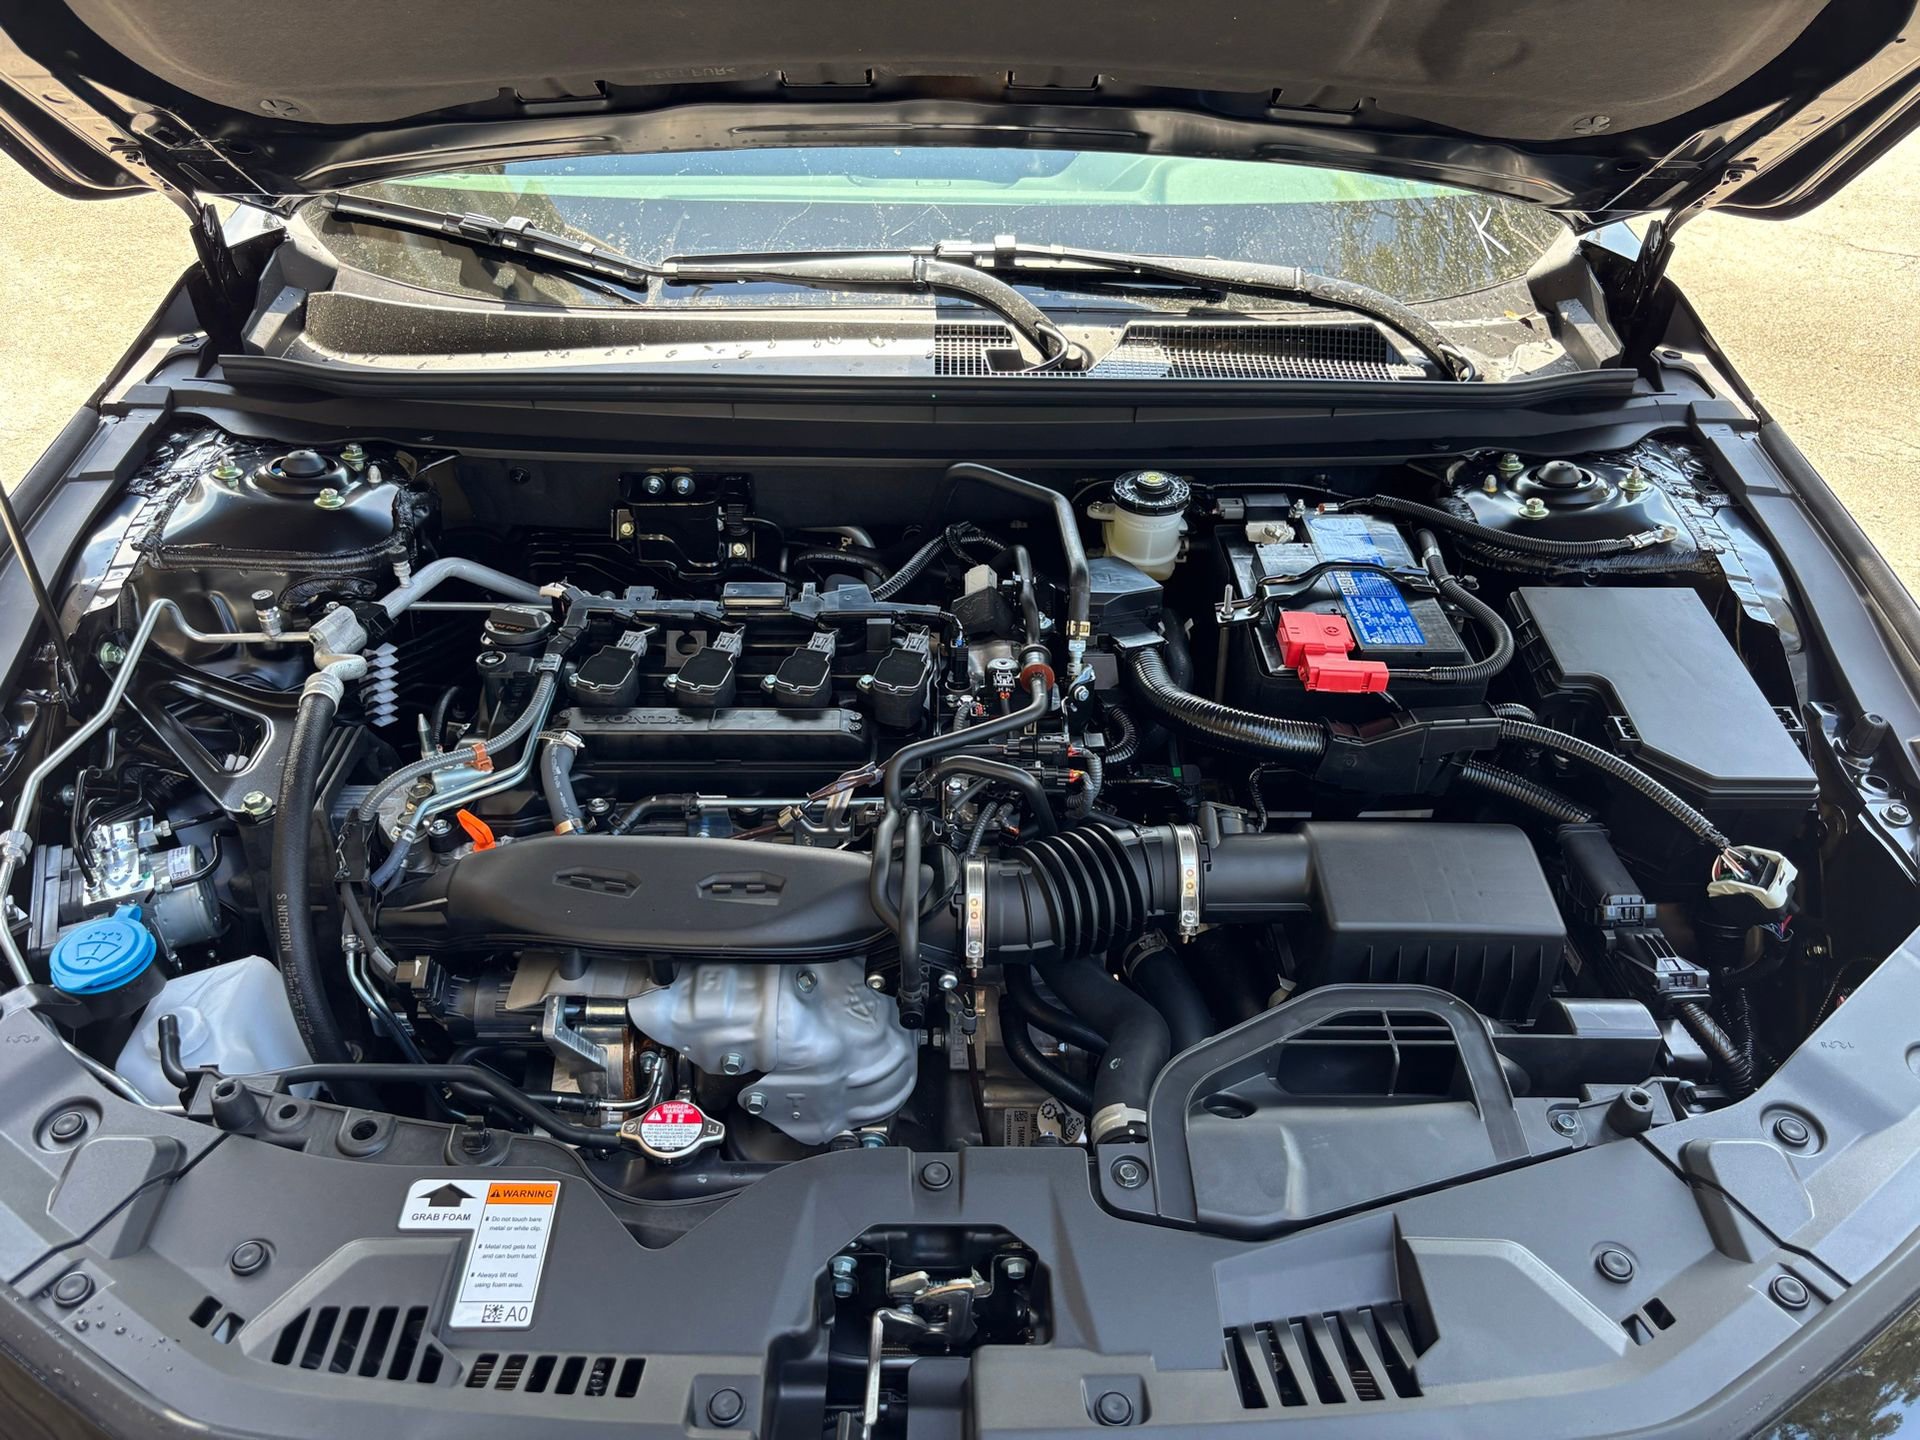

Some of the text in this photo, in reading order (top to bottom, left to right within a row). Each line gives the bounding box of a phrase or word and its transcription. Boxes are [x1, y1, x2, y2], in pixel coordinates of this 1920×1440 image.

[1468, 207, 1510, 260] K
[584, 714, 694, 725] HONDA
[502, 1189, 553, 1198] WARNING
[411, 1213, 471, 1221] GRAB FOAM
[504, 1306, 528, 1322] A0
